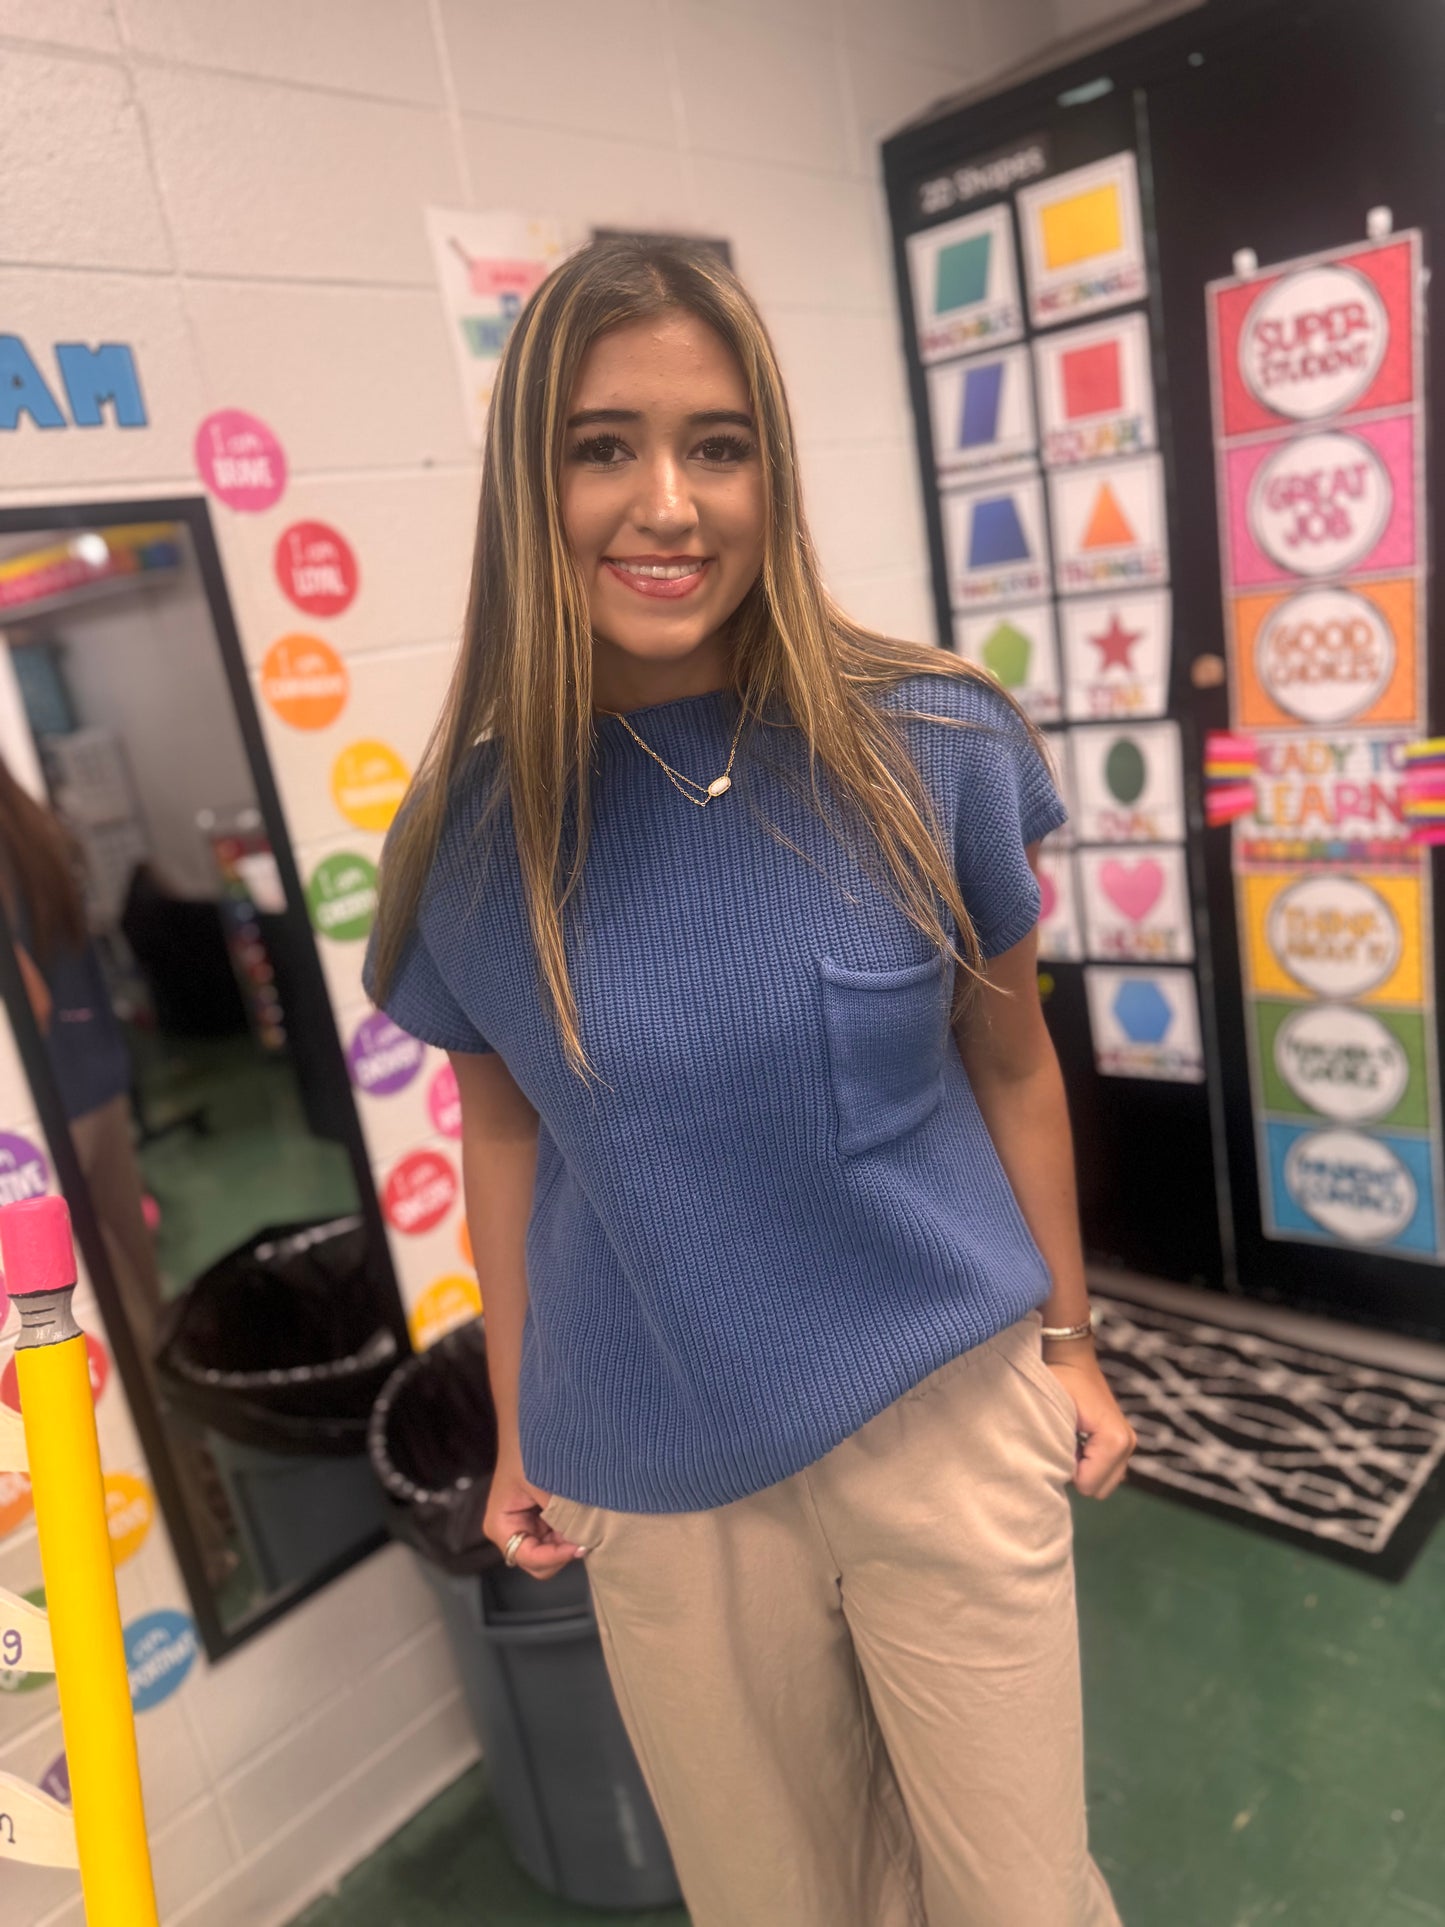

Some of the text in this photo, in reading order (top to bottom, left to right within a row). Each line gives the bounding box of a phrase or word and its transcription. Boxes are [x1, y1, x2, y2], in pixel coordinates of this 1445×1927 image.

[1254, 300, 1371, 352] SUPER
[0, 333, 148, 430] AM
[1261, 341, 1368, 388] STUDENT
[1266, 460, 1369, 513] GREAT
[1284, 503, 1353, 548] JOB
[1272, 617, 1376, 660] GOOD
[1256, 735, 1352, 776] EADY
